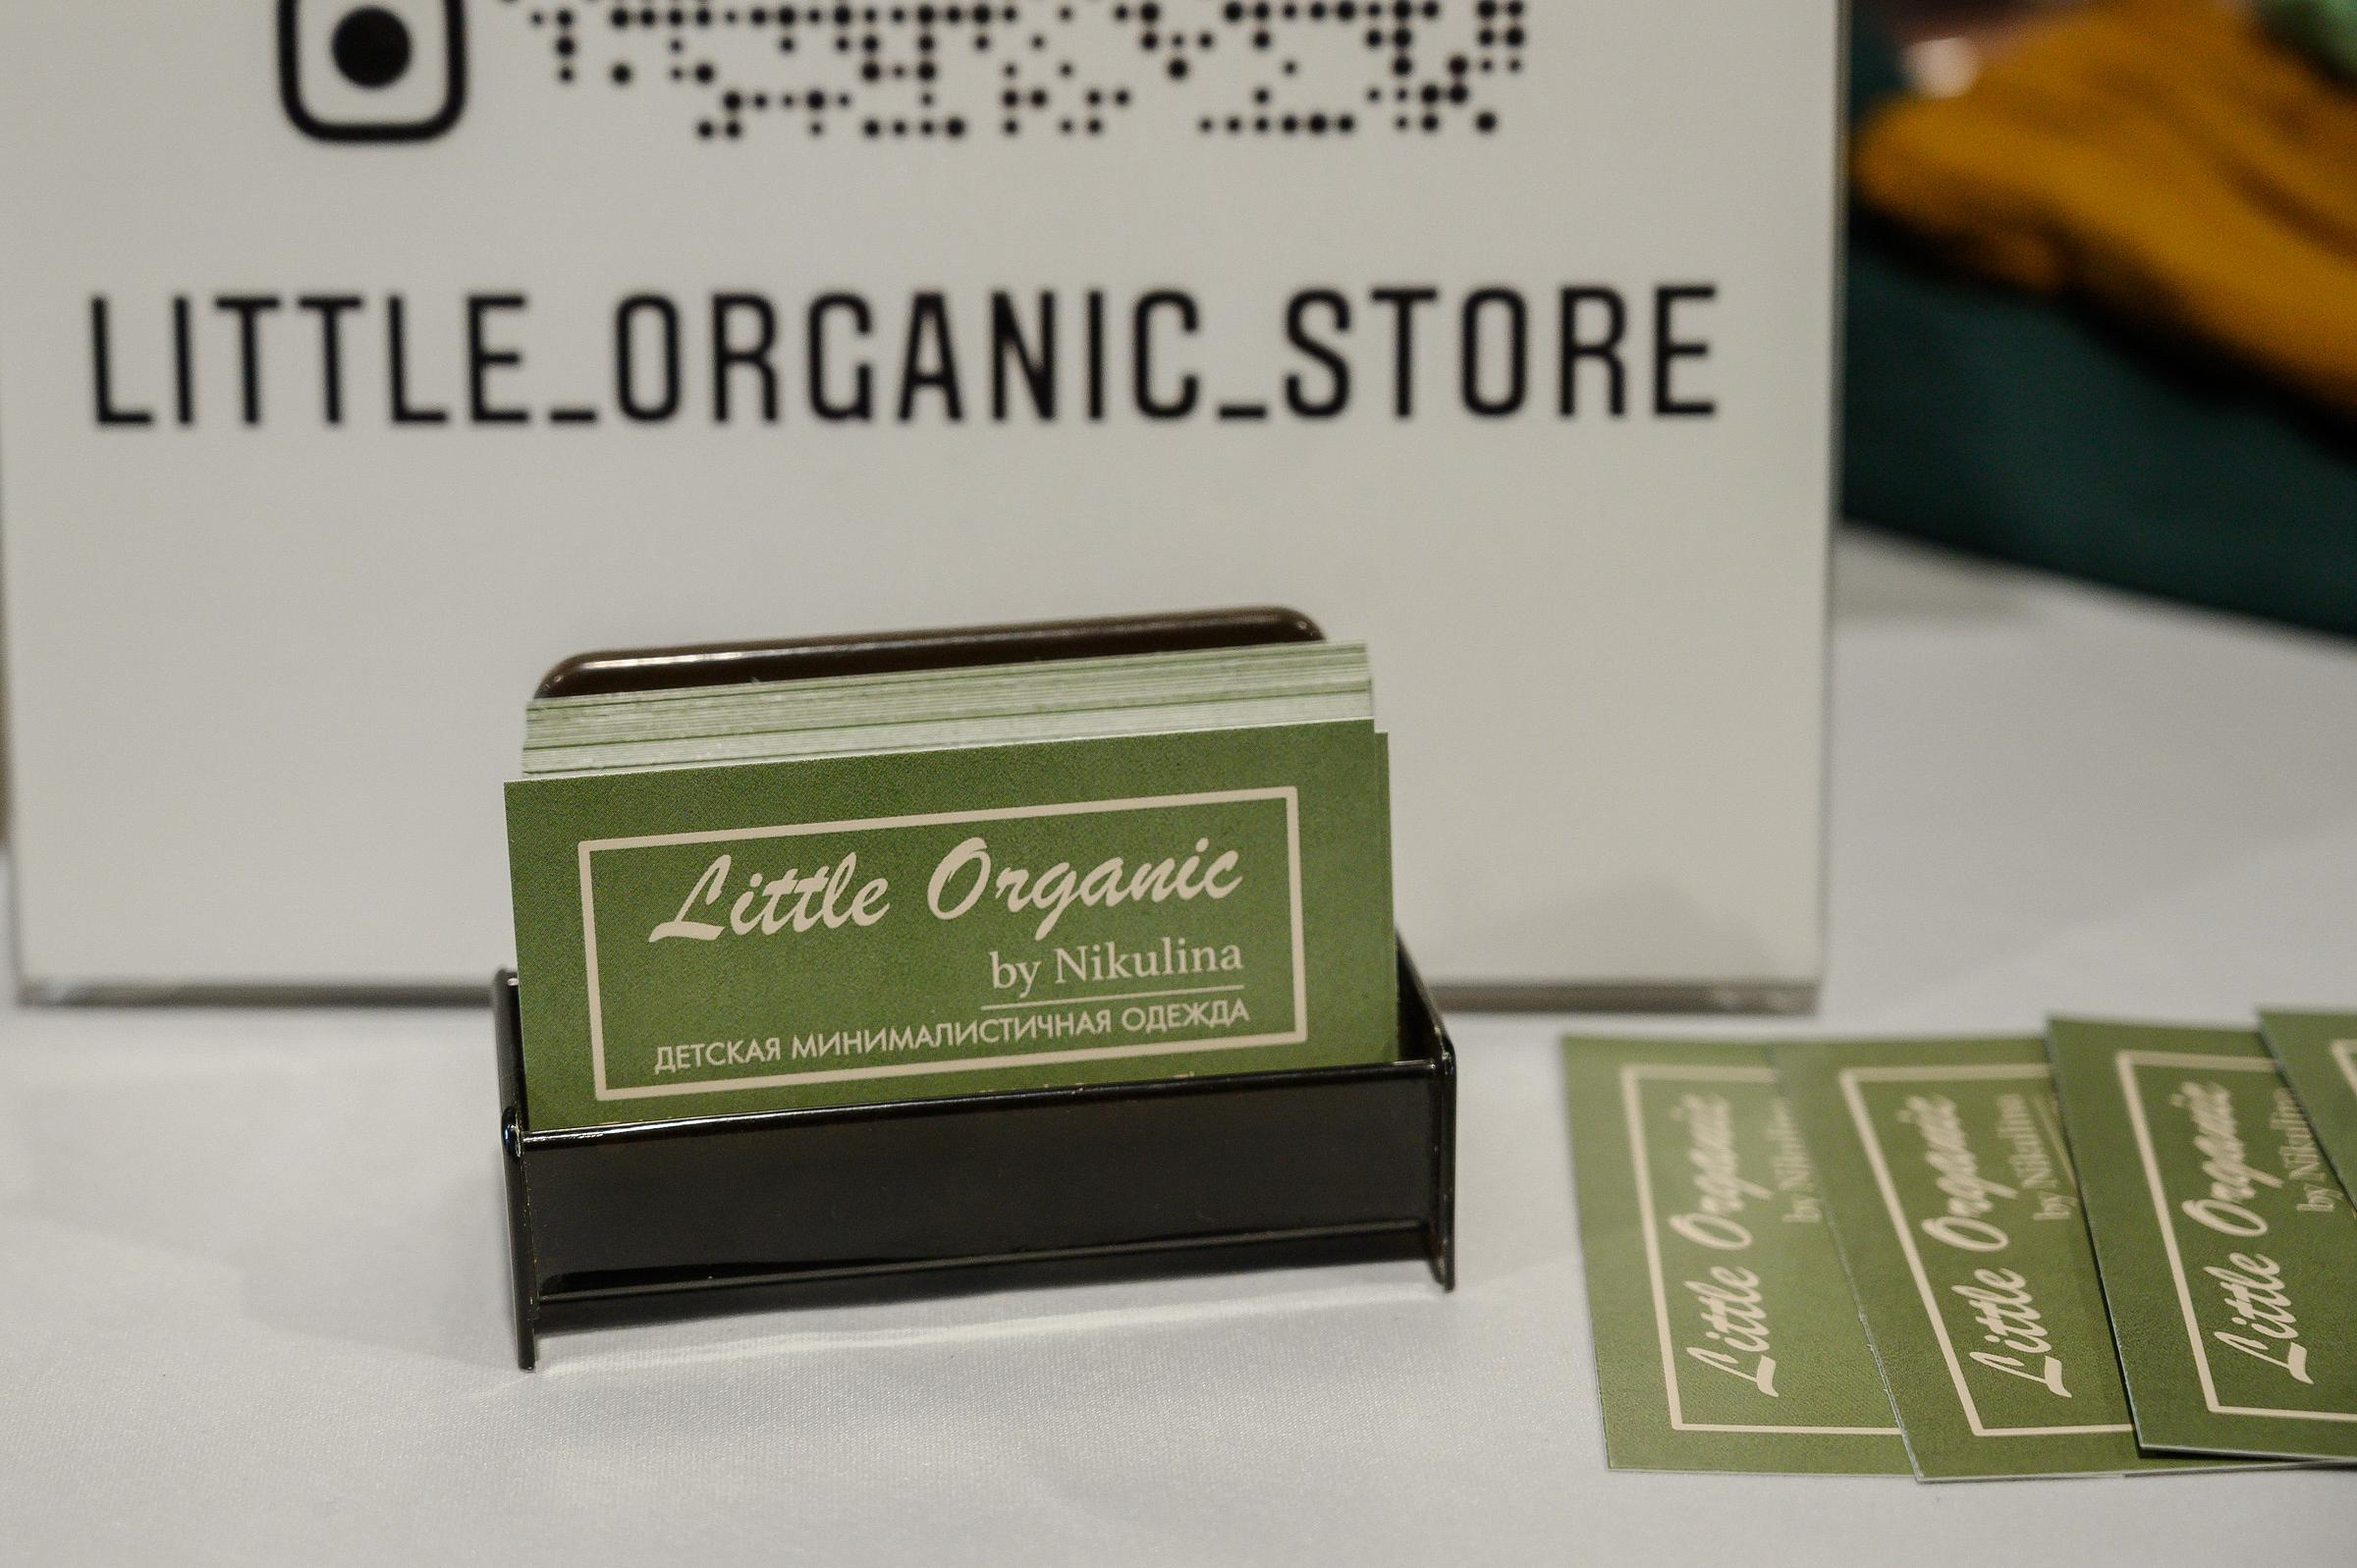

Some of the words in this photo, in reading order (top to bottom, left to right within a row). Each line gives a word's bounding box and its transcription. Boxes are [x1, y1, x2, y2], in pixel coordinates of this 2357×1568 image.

[90, 284, 1718, 427] LITTLE_ORGANIC_STORE
[648, 851, 890, 944] Little
[926, 837, 1244, 942] Organic
[990, 950, 1042, 1000] by
[1054, 937, 1244, 985] Nikulina
[654, 1036, 782, 1076] ДЕТСКАЯ
[791, 1007, 1113, 1060] МИНИМАЛИСТИЧНАЯ
[1122, 998, 1250, 1035] ОДЕЖДА
[1670, 1092, 1774, 1251] Organic
[1781, 1194, 1824, 1223] by
[1896, 1092, 2019, 1253] Organic
[2033, 1191, 2079, 1220] by
[2169, 1080, 2284, 1238] Organic
[2296, 1183, 2344, 1212] by
[1683, 1266, 1780, 1398] Little
[1951, 1267, 2073, 1398] Little
[2203, 1252, 2314, 1385] Little
